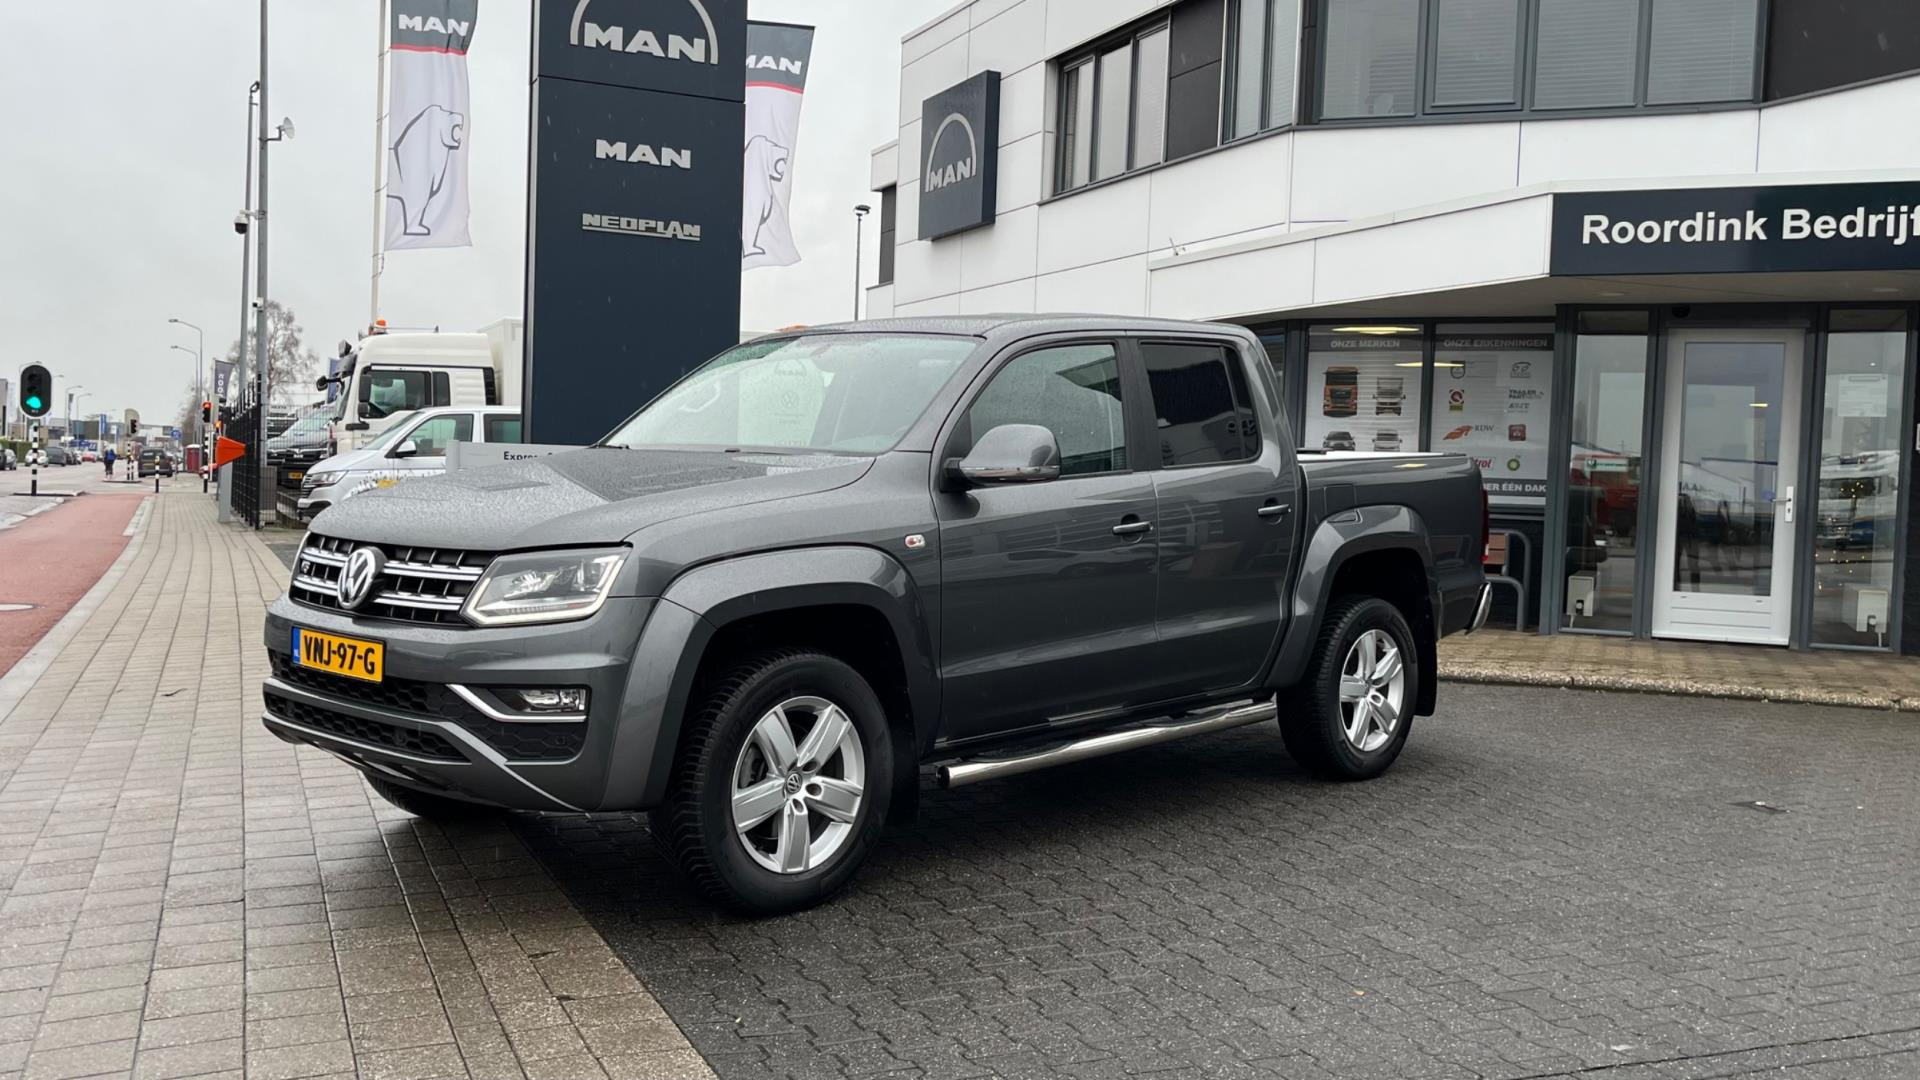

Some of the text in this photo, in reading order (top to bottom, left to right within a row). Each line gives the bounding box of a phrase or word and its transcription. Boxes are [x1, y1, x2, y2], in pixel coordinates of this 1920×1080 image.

[399, 14, 469, 37] MAN
[584, 22, 705, 63] MAN
[596, 139, 691, 169] MAN
[930, 157, 972, 183] MAN
[582, 213, 701, 239] NEOPLAN
[1582, 205, 1920, 246] Roordink Bedrijf
[1330, 339, 1400, 348] ONZE MERKEN
[1443, 339, 1473, 348] ONZE
[1524, 483, 1547, 492] DAK
[304, 634, 376, 675] VNJ-97-G
